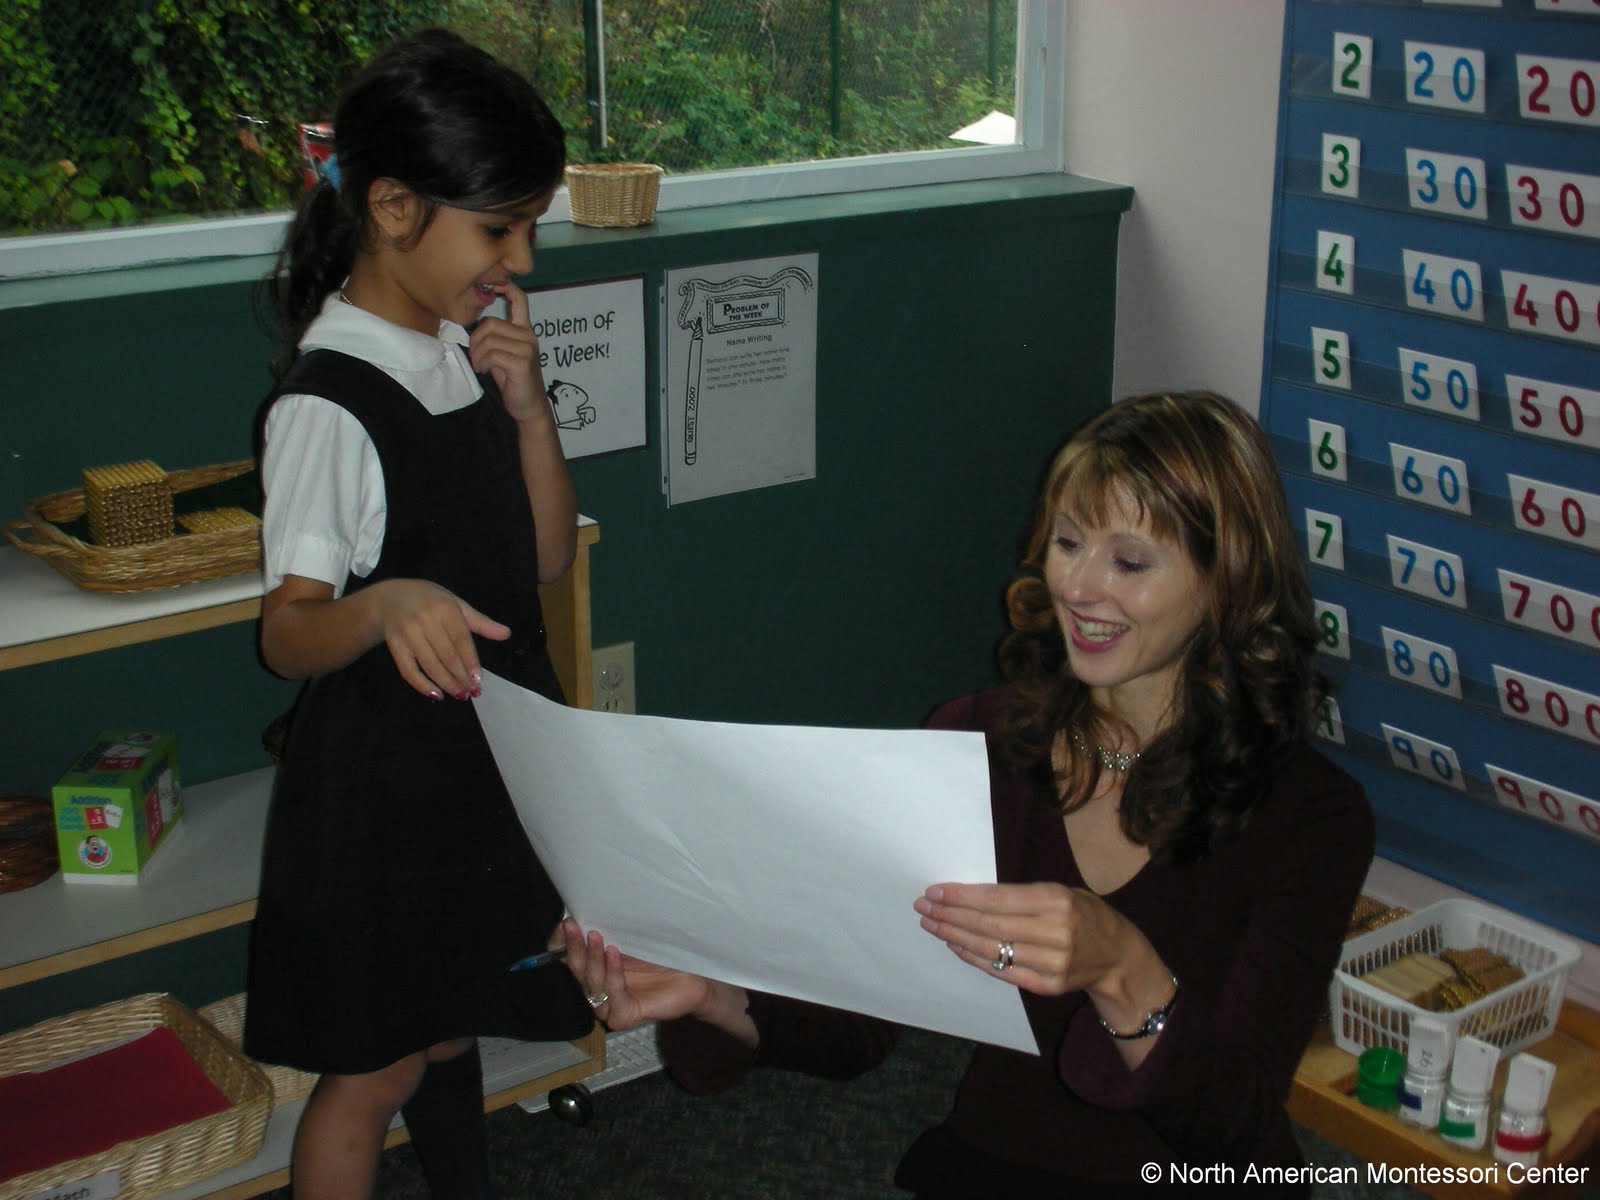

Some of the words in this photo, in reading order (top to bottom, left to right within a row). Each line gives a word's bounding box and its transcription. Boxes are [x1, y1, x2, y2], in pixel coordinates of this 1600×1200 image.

[1341, 43, 1361, 89] 2
[1413, 51, 1475, 102] 20
[1329, 144, 1349, 188] 3
[1416, 159, 1477, 210] 30
[1323, 243, 1345, 285] 4
[1412, 262, 1473, 310] 40
[533, 317, 587, 338] oblem
[594, 311, 615, 331] of
[723, 303, 759, 315] PROBLEM
[729, 313, 741, 321] THE
[744, 311, 763, 320] WEEK
[1513, 284, 1600, 333] 40
[553, 342, 609, 368] Week!
[726, 338, 746, 346] Name
[748, 334, 772, 344] Writing
[1321, 339, 1341, 379] 5
[688, 386, 696, 411] 2000
[1410, 361, 1469, 410] 50
[687, 416, 695, 443] QUEST
[1317, 431, 1337, 471] 6
[1401, 456, 1459, 505] 60
[1315, 519, 1333, 559] 7
[1397, 546, 1456, 598] 70
[1319, 610, 1339, 649] 8
[1392, 639, 1450, 688] 80
[1505, 678, 1600, 739] 800
[1391, 736, 1453, 781] 90
[1497, 776, 1600, 836] 900
